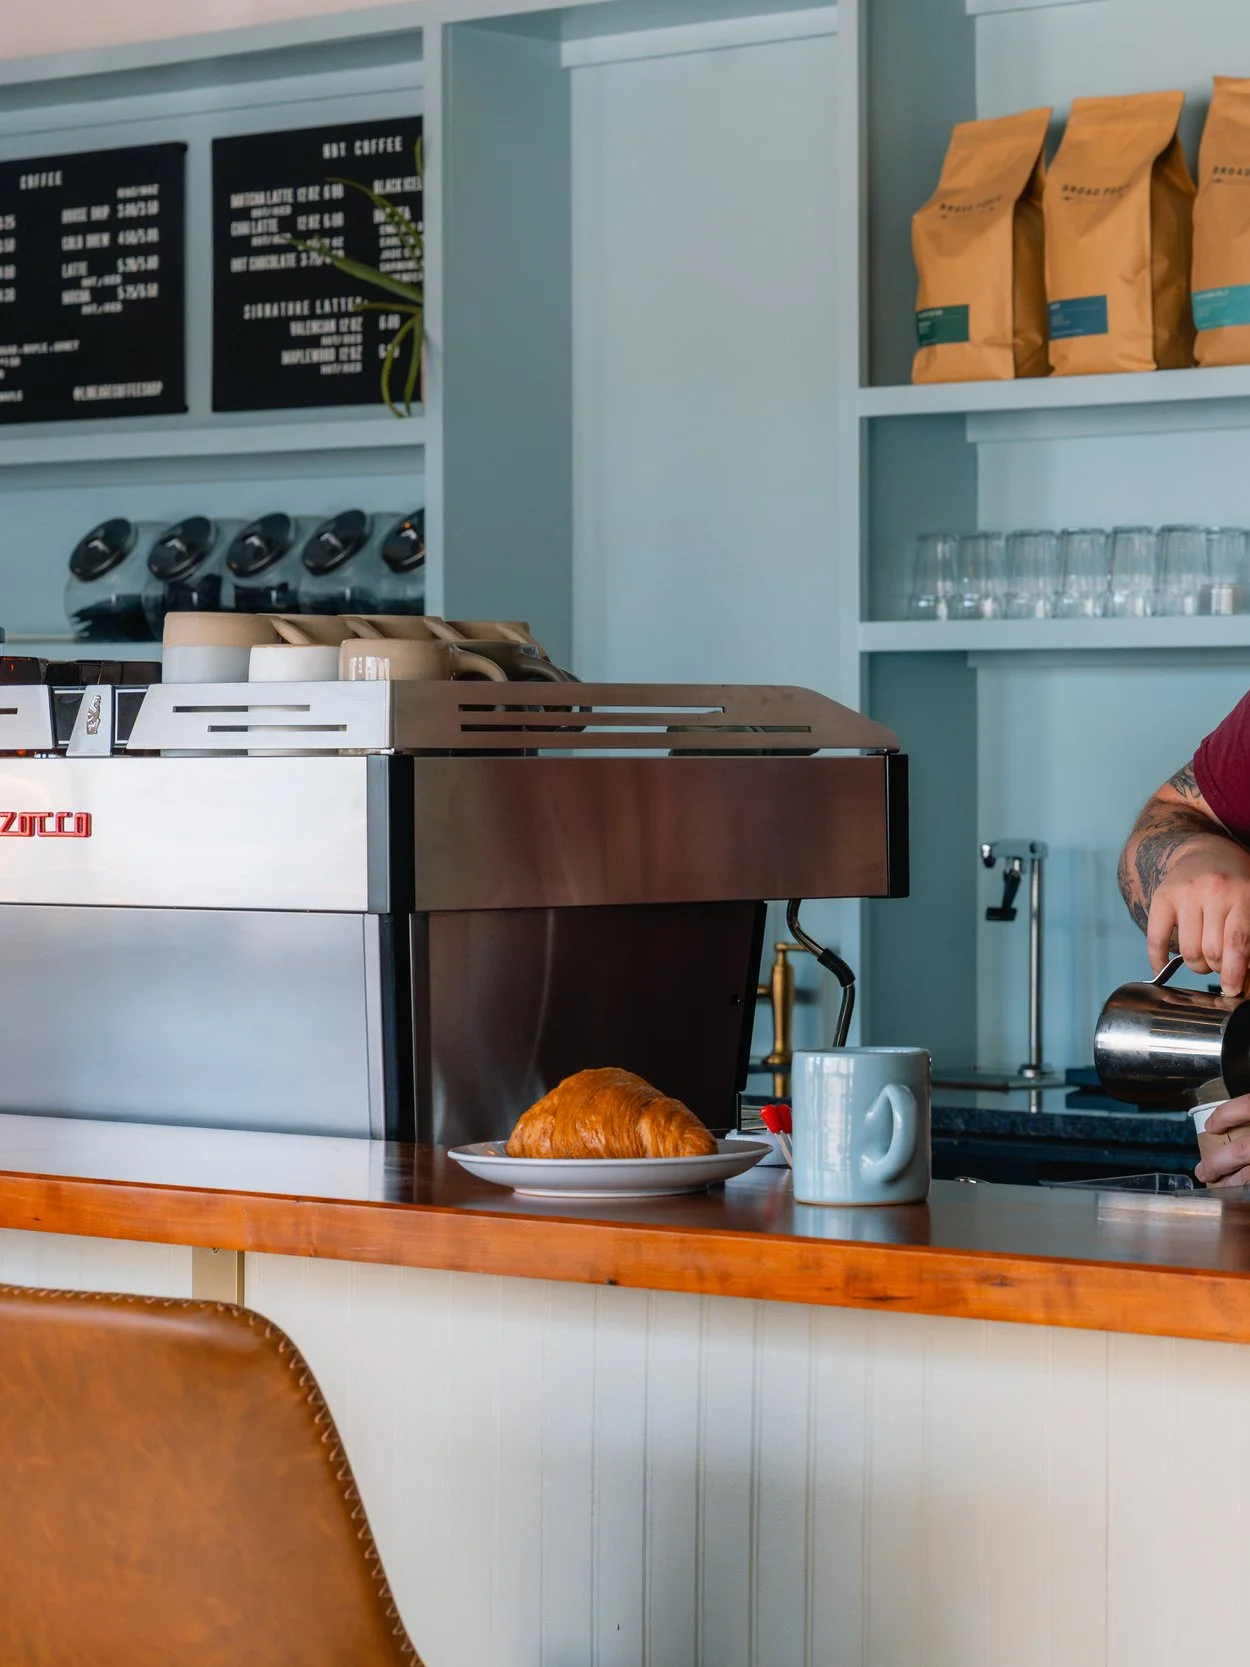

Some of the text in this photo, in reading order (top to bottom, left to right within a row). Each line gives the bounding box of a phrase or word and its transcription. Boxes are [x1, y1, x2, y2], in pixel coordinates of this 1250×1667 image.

[322, 136, 403, 159] HOT COFFEE
[20, 170, 63, 190] COFFEE
[266, 188, 295, 206] LATTE
[251, 217, 279, 235] LATTE
[61, 234, 84, 251] COLD
[85, 231, 111, 249] BREW
[61, 260, 89, 279] LATTE
[243, 299, 311, 320] SIGNATURE
